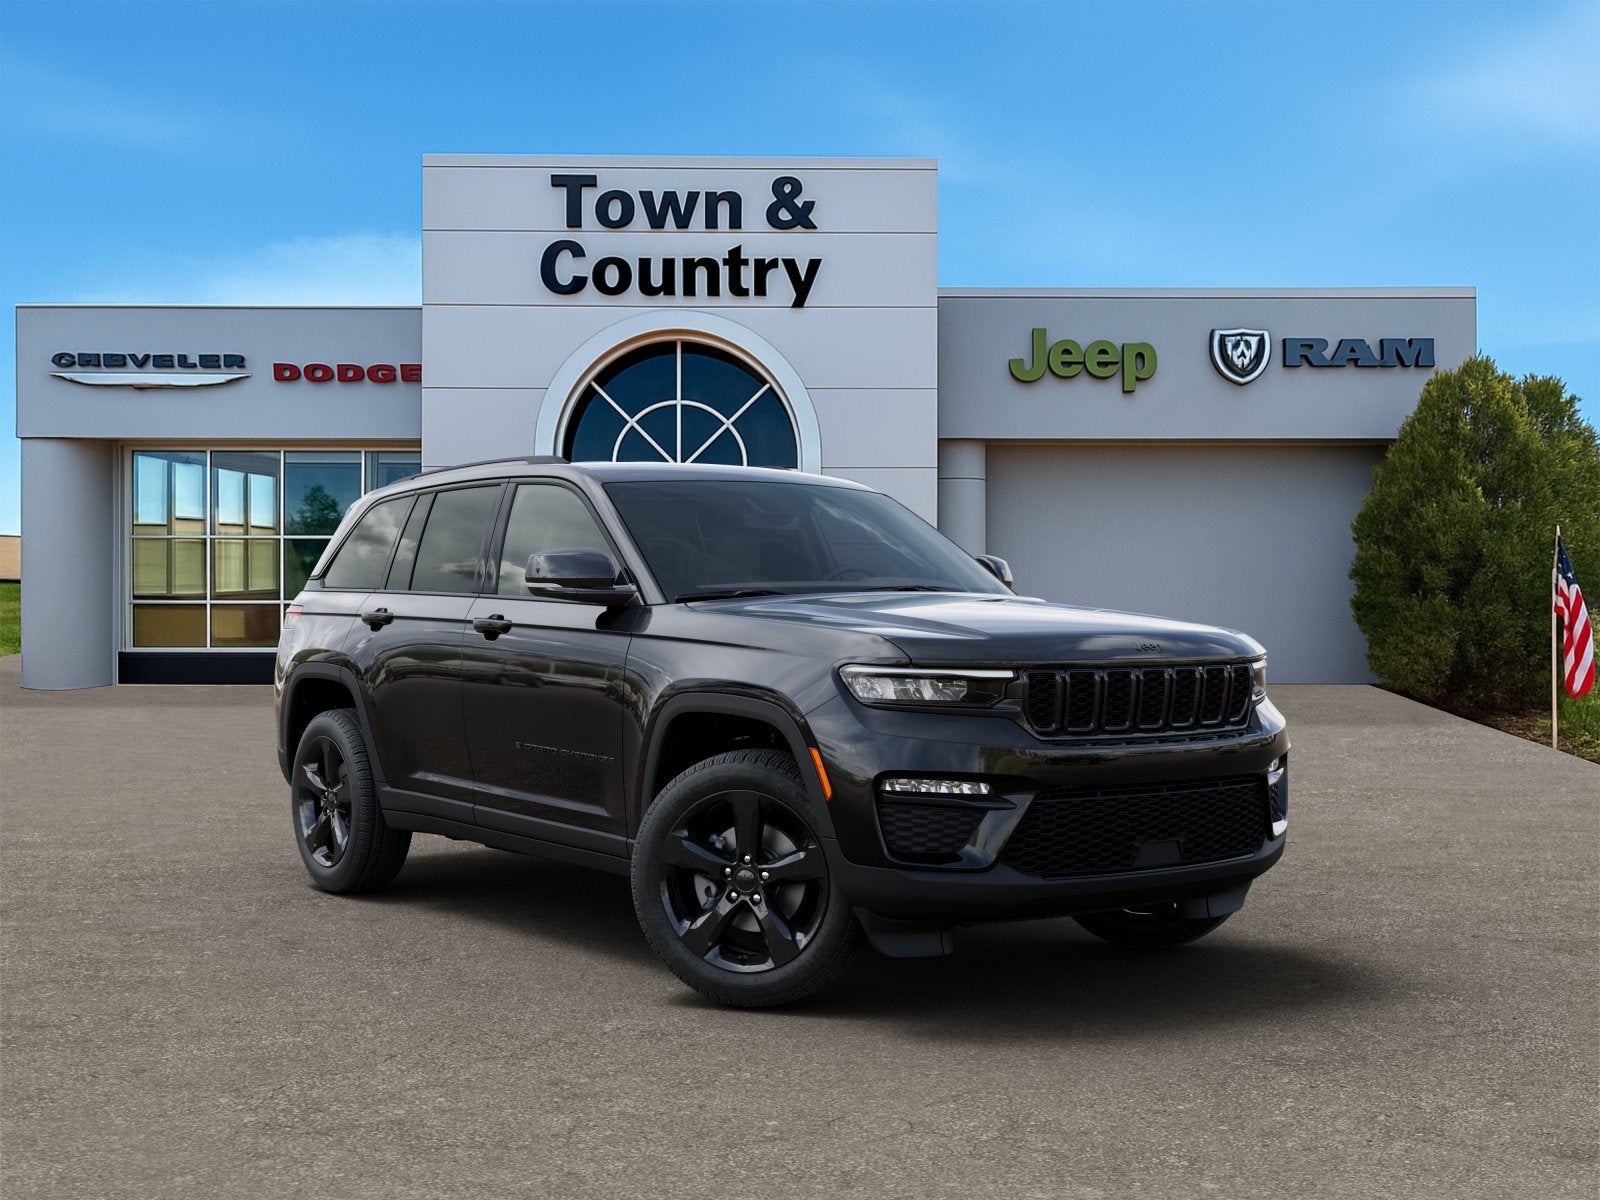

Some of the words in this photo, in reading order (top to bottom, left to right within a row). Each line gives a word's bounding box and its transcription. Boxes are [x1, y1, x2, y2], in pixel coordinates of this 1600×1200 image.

[550, 174, 743, 230] Town
[765, 175, 818, 230] &
[540, 239, 822, 308] Country
[272, 363, 422, 383] DODGE
[1009, 328, 1157, 393] Jeep
[1283, 337, 1435, 367] RAM
